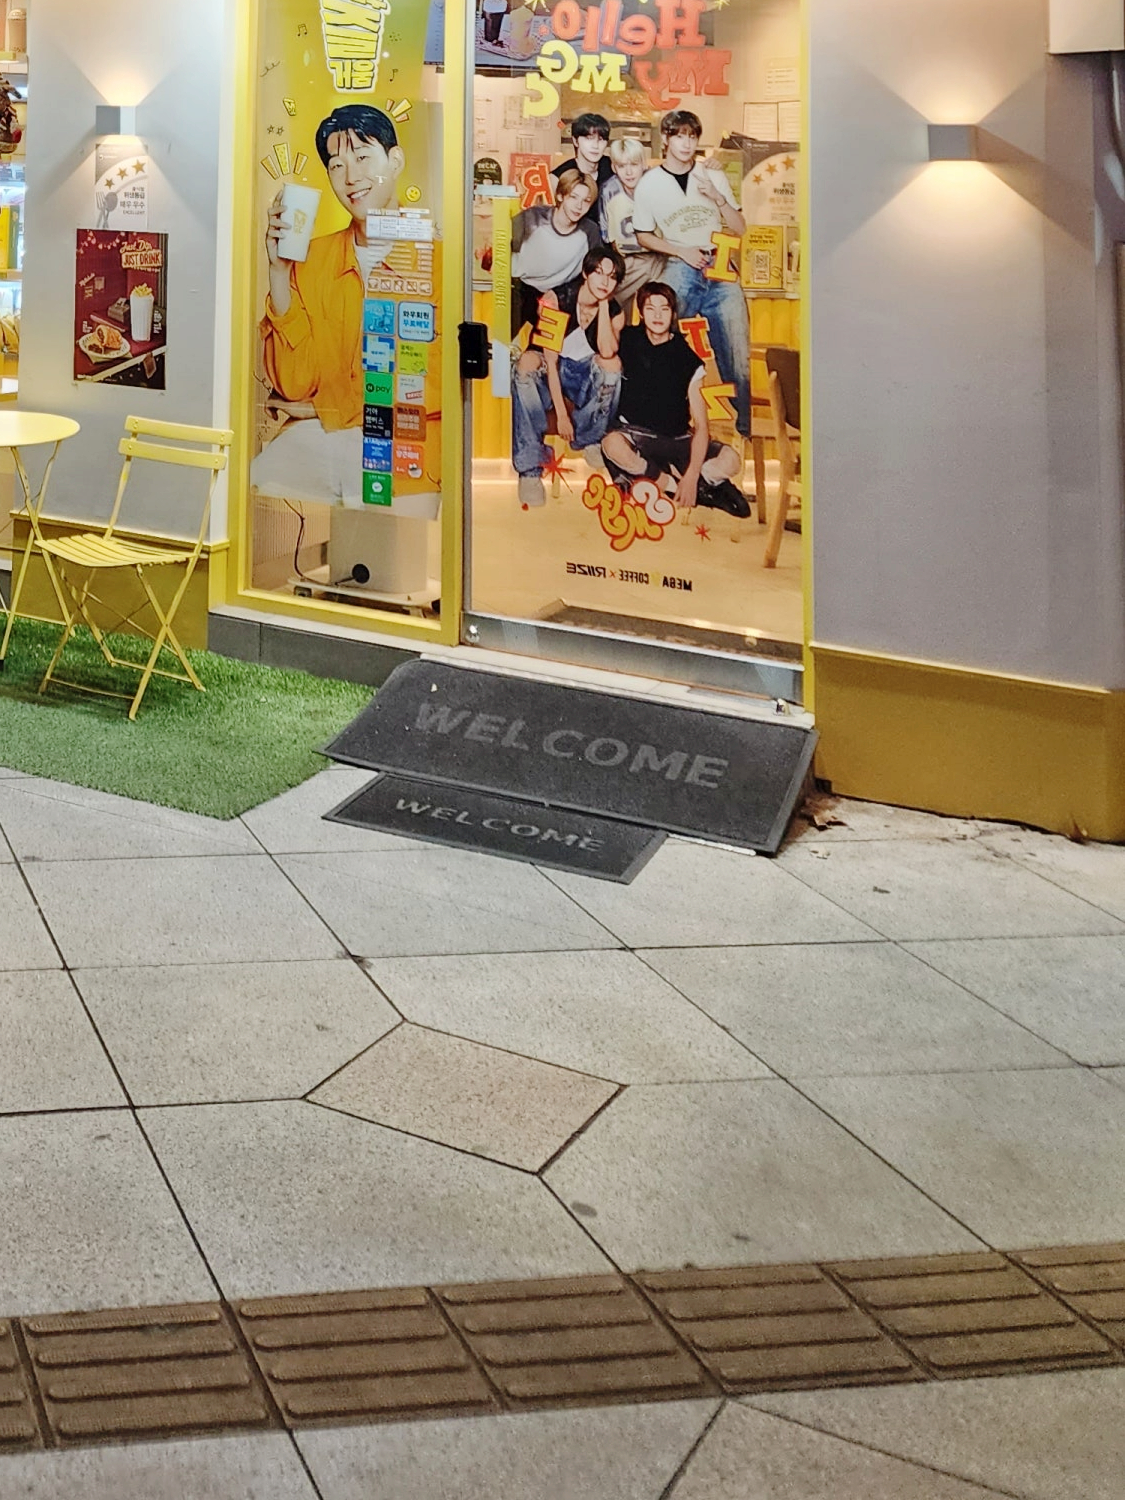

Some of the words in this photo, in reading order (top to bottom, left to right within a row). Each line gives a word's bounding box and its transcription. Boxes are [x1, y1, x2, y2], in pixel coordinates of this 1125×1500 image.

[123, 252, 139, 267] JUST
[139, 252, 162, 266] DRINK
[413, 700, 730, 790] WELCOME
[395, 797, 608, 854] WELCOME
